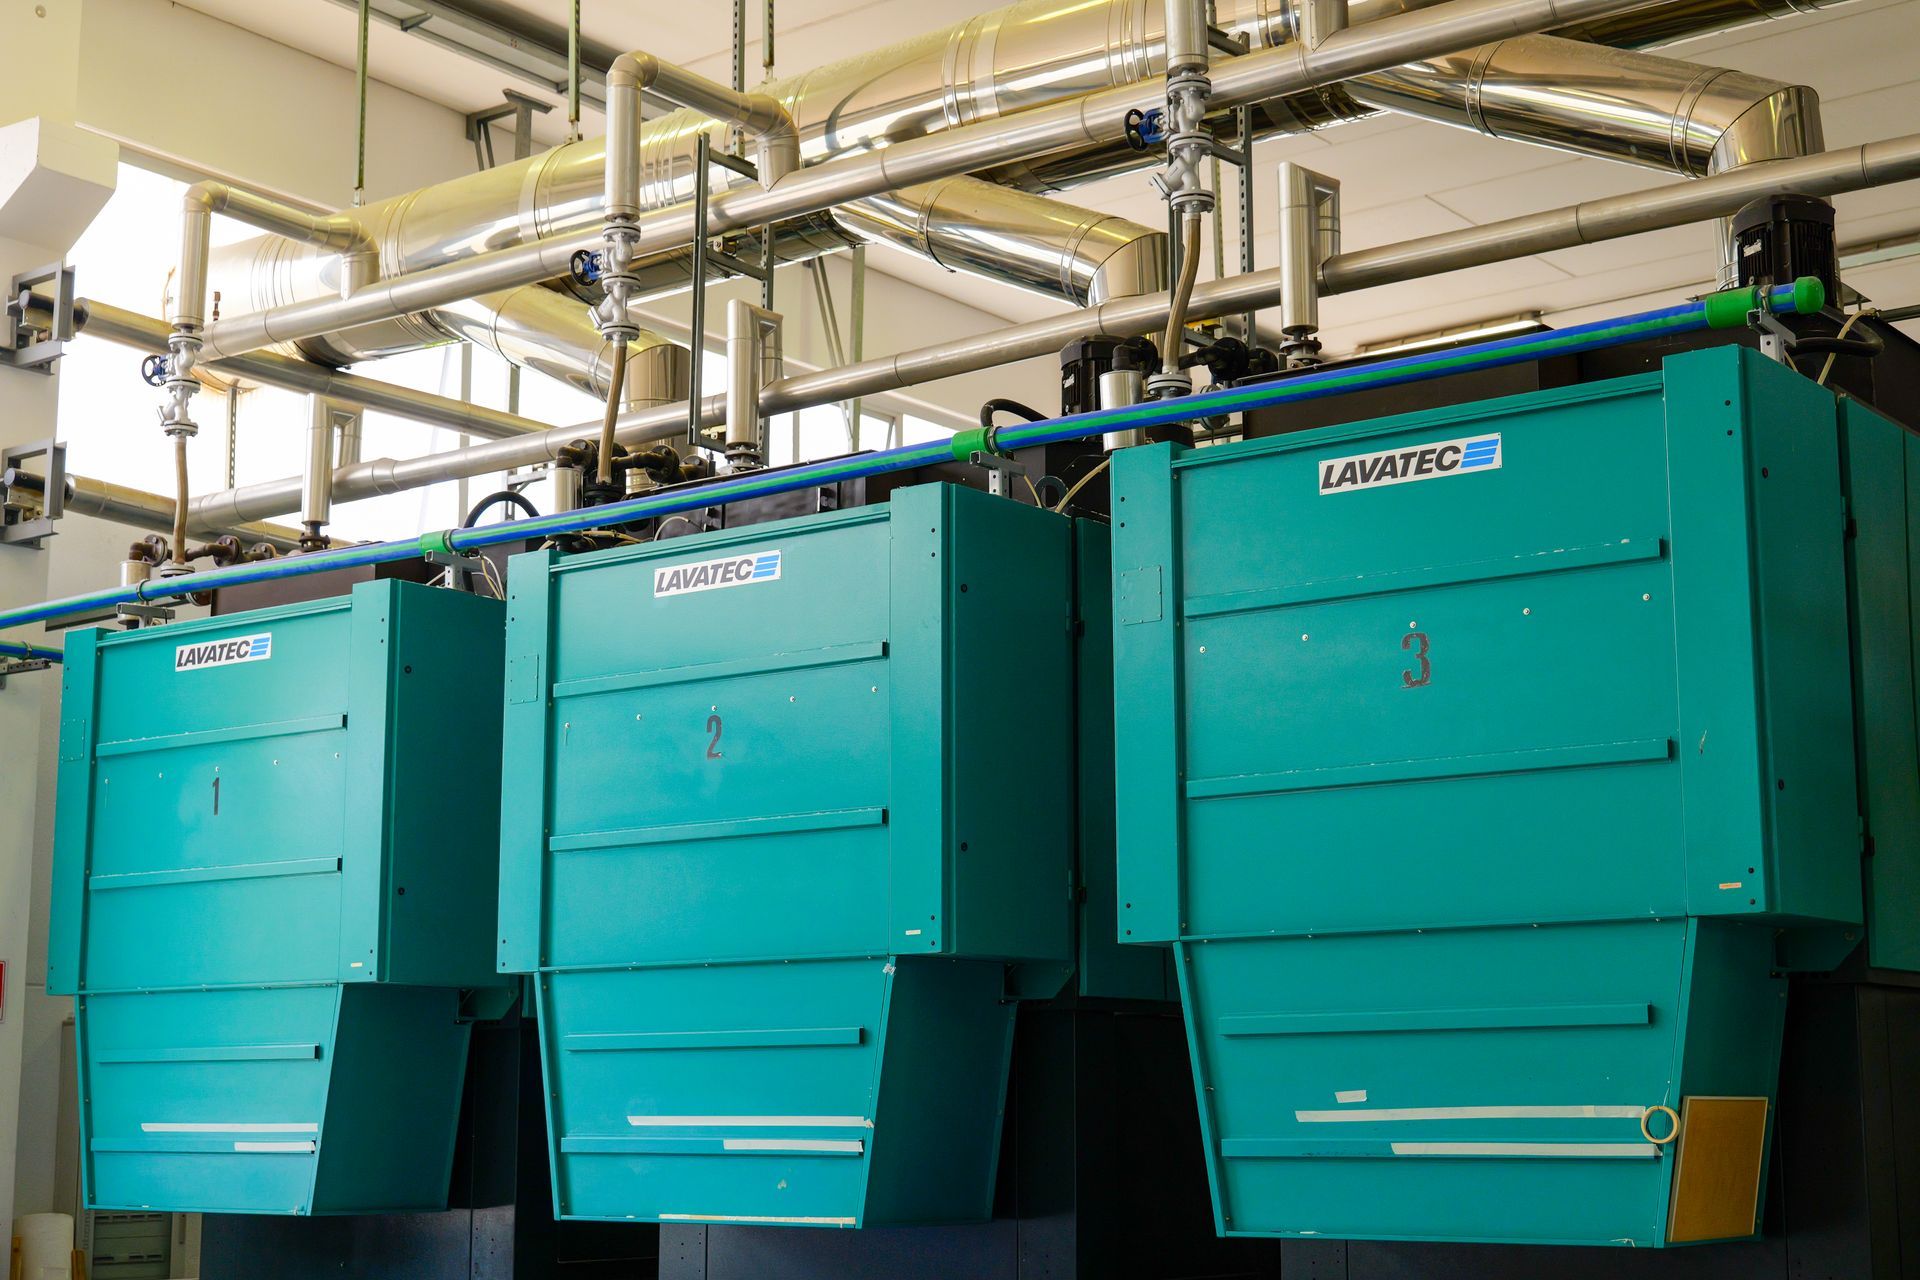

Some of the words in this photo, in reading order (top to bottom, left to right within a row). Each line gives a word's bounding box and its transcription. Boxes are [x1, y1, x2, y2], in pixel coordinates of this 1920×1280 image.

[1321, 445, 1461, 490] LAVATEC
[655, 559, 753, 593] LAVATEC
[176, 640, 250, 667] LAVATEC
[1401, 632, 1430, 687] 3
[707, 715, 721, 760] 2
[212, 777, 219, 816] 1
